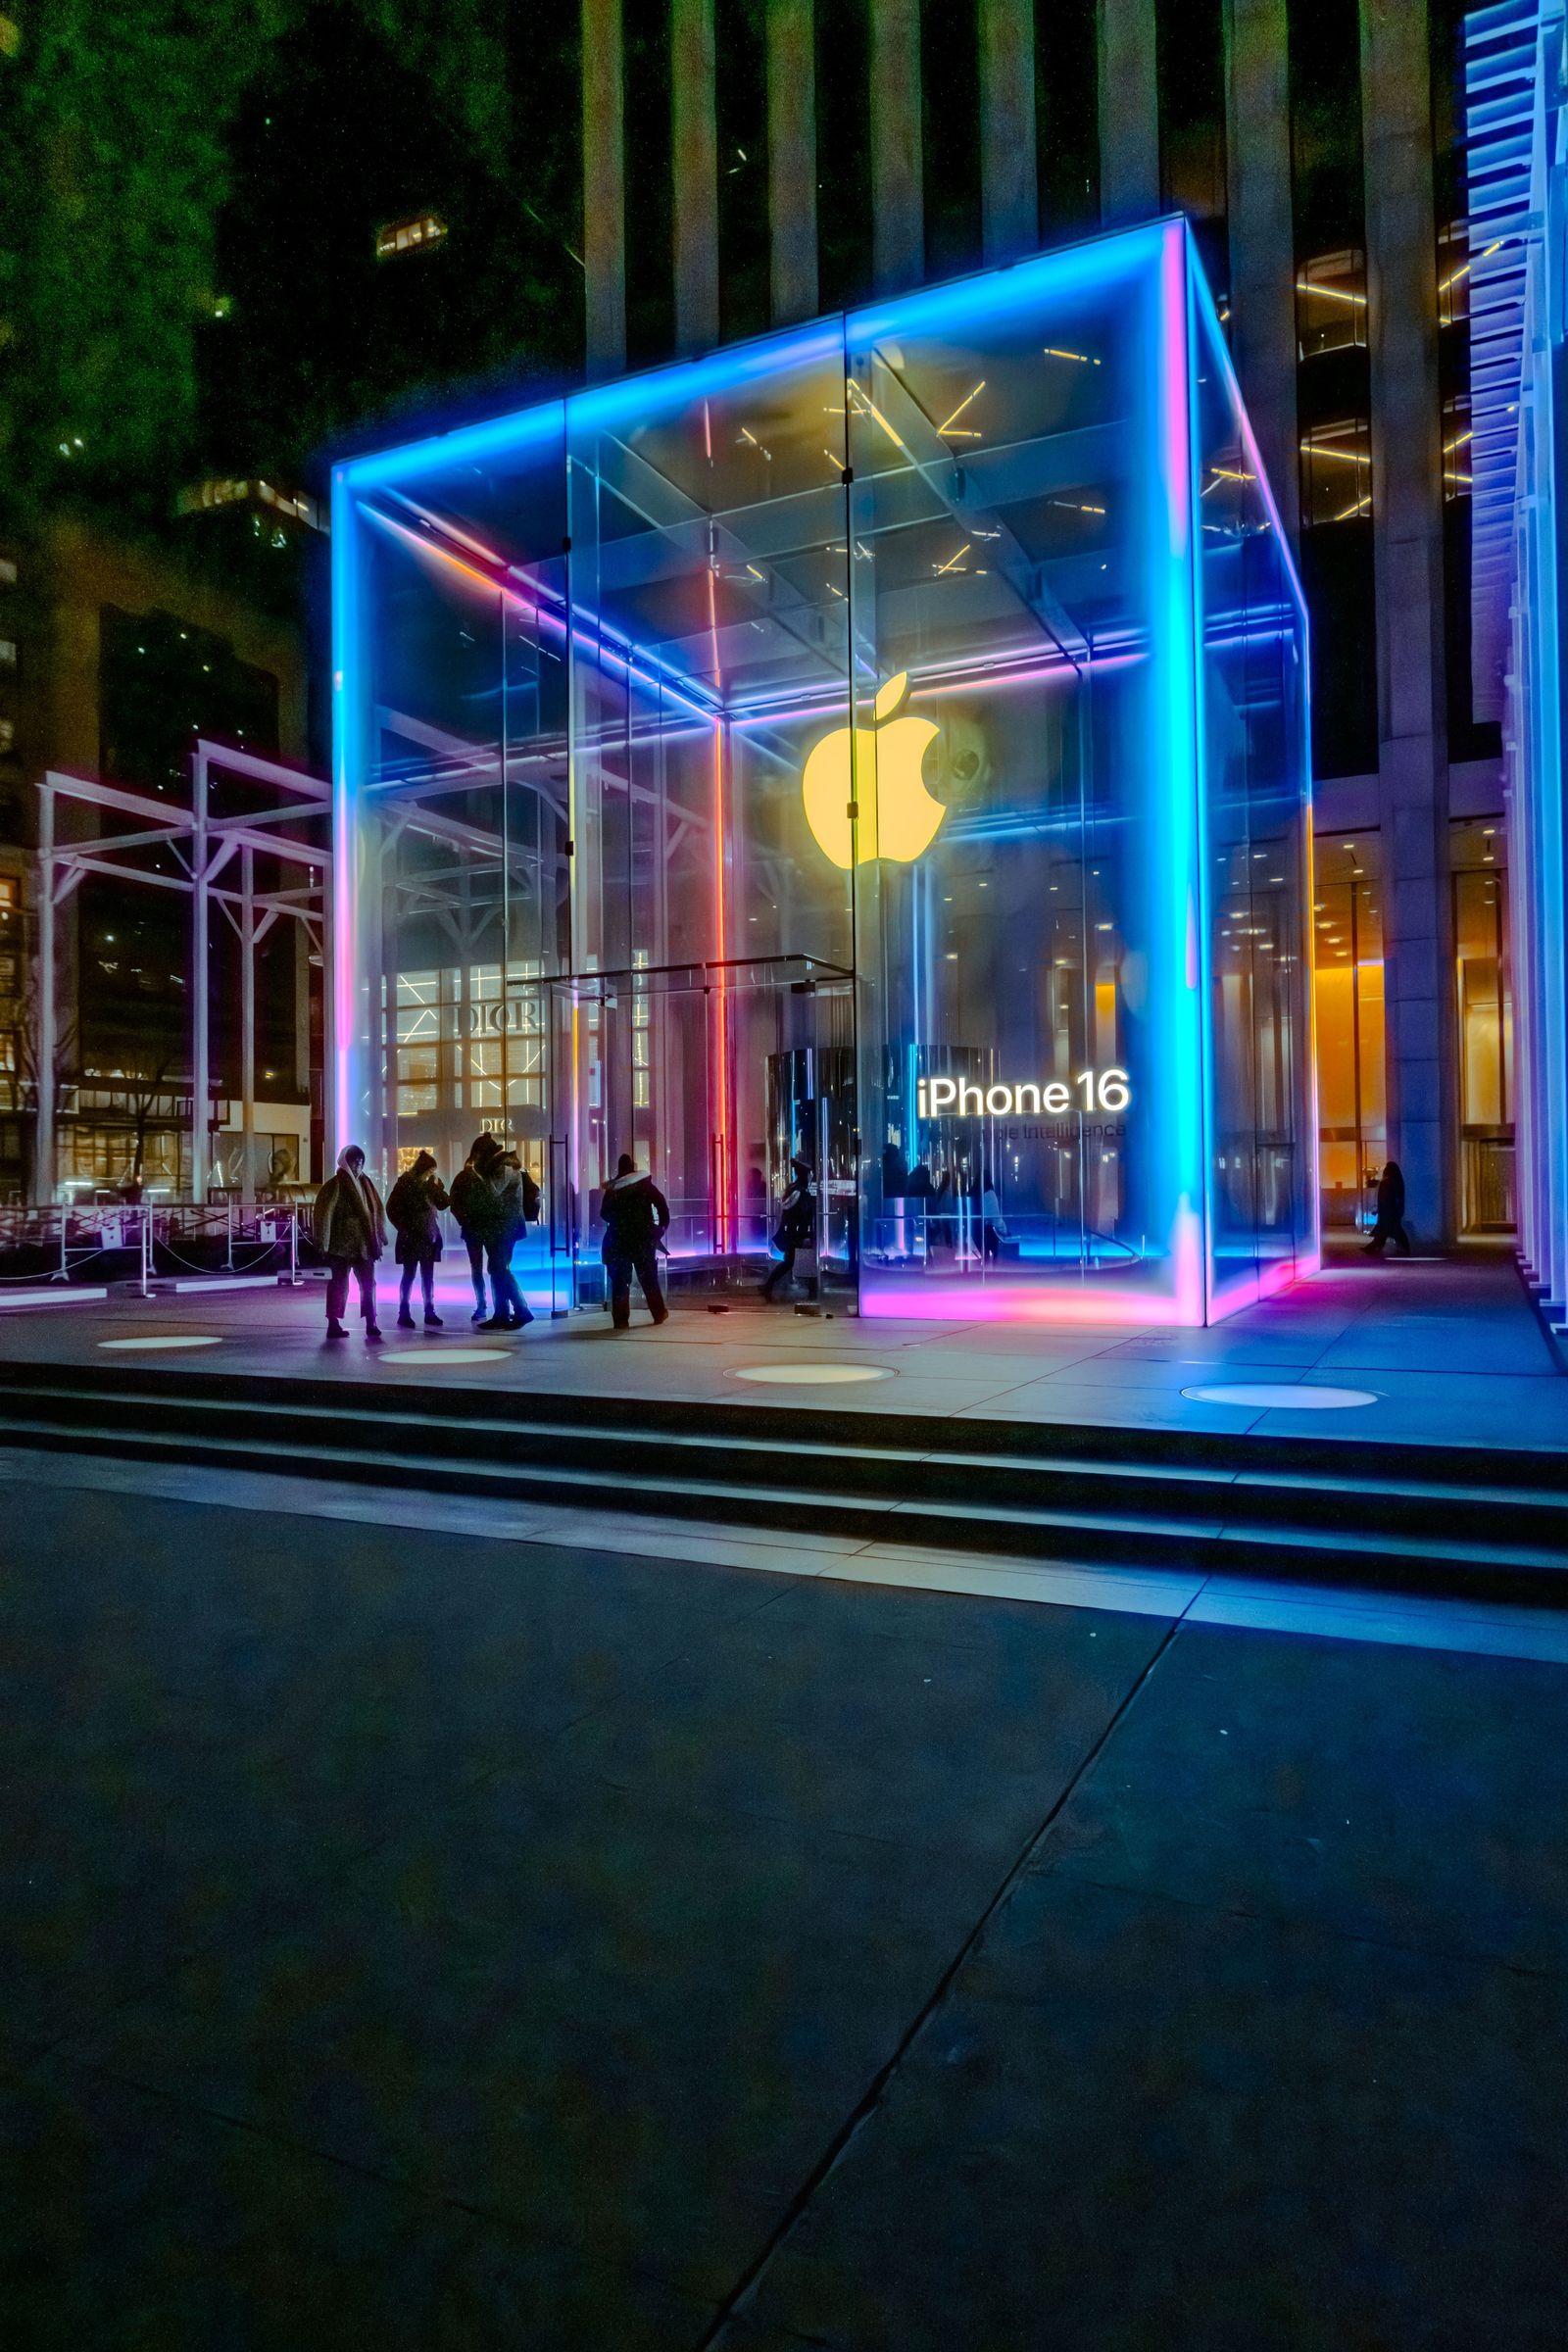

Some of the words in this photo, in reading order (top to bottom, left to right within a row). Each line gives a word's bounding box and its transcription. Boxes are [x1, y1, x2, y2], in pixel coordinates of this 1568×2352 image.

[458, 1002, 538, 1036] DIOR
[918, 1076, 1069, 1118] iPhone
[1076, 1068, 1130, 1112] 16
